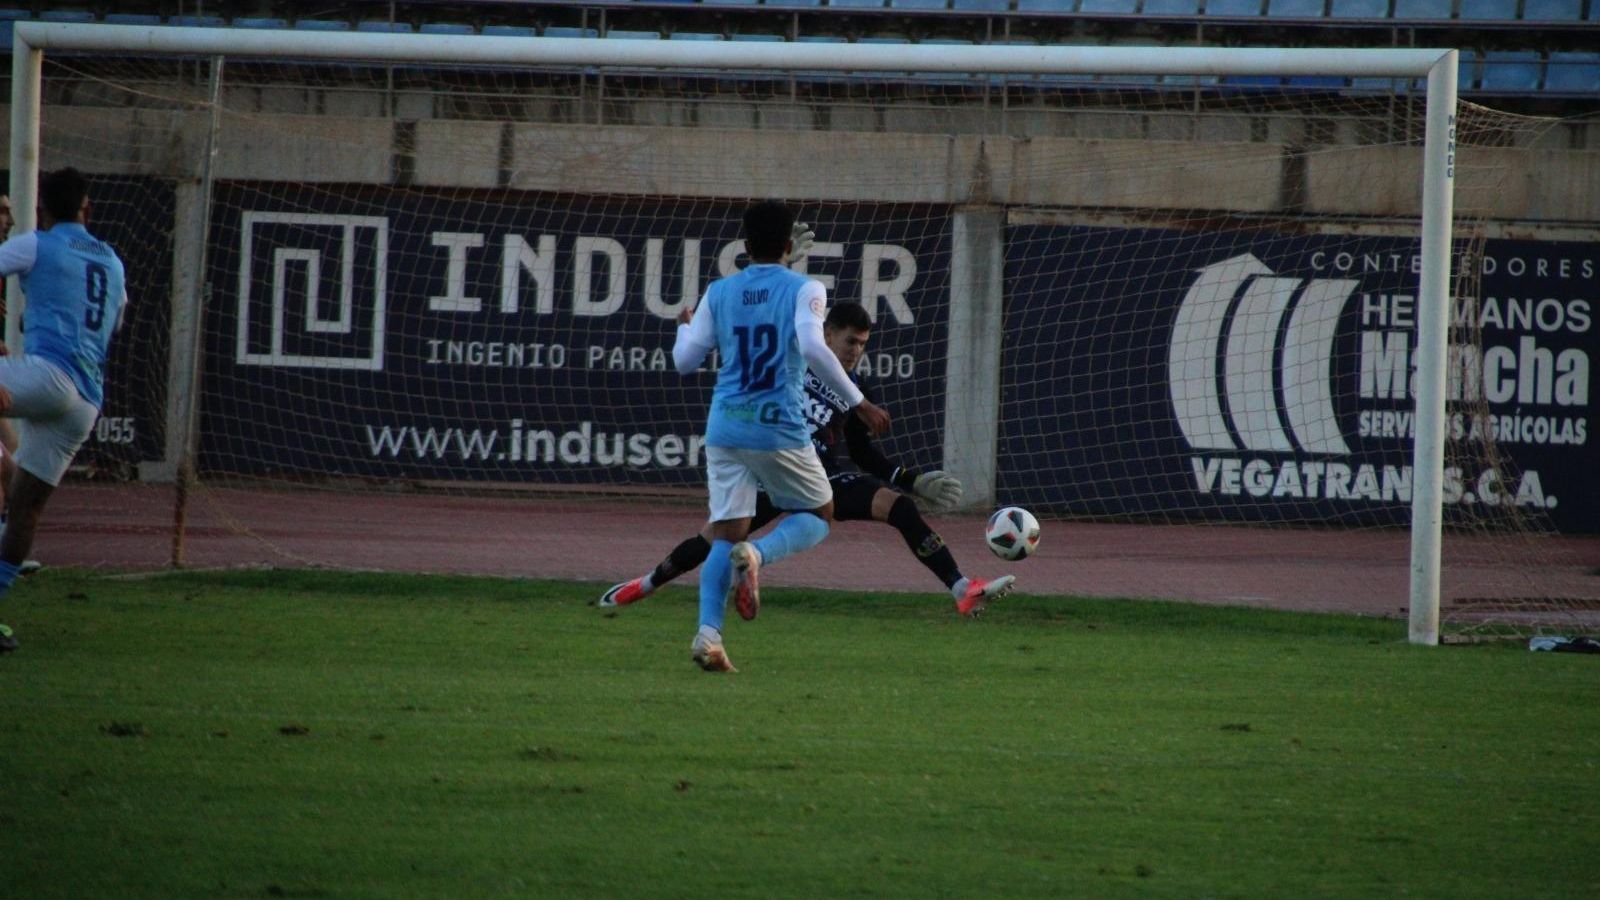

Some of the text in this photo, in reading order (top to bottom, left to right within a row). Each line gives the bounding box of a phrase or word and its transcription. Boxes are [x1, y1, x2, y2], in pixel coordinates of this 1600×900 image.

[1311, 251, 1594, 279] CONTEEDORES
[85, 263, 108, 331] 9
[742, 288, 769, 306] SILVA
[1362, 294, 1592, 333] HEMANOS
[426, 339, 566, 369] INGENIO
[588, 346, 667, 371] PARA
[733, 323, 778, 392] 12
[1359, 330, 1590, 406] Mncha
[1359, 407, 1588, 445] SERVIS AGRÍCOLAS
